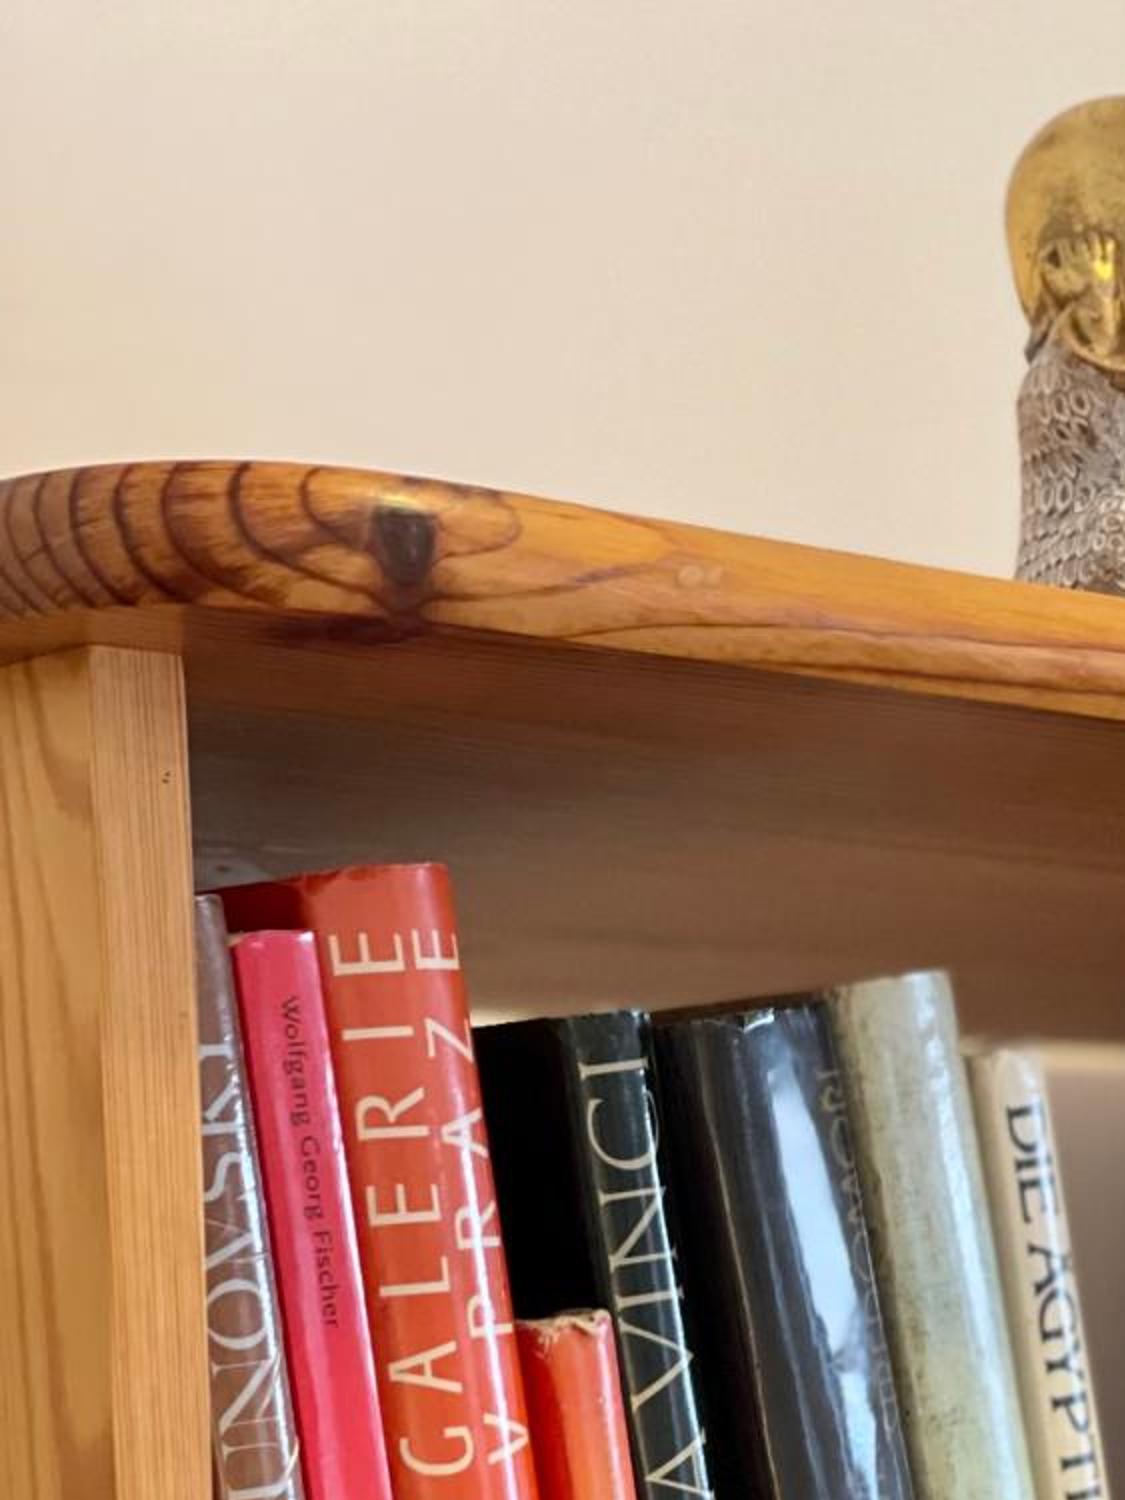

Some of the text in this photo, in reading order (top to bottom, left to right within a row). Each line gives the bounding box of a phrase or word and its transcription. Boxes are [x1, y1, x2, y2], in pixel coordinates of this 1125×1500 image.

[280, 994, 341, 1329] Wolfgang Georg Fischer
[327, 929, 476, 1477] GALERIE
[411, 929, 531, 1466] V PRAZE
[577, 1056, 695, 1414] VINCI
[1004, 1104, 1063, 1226] DIE
